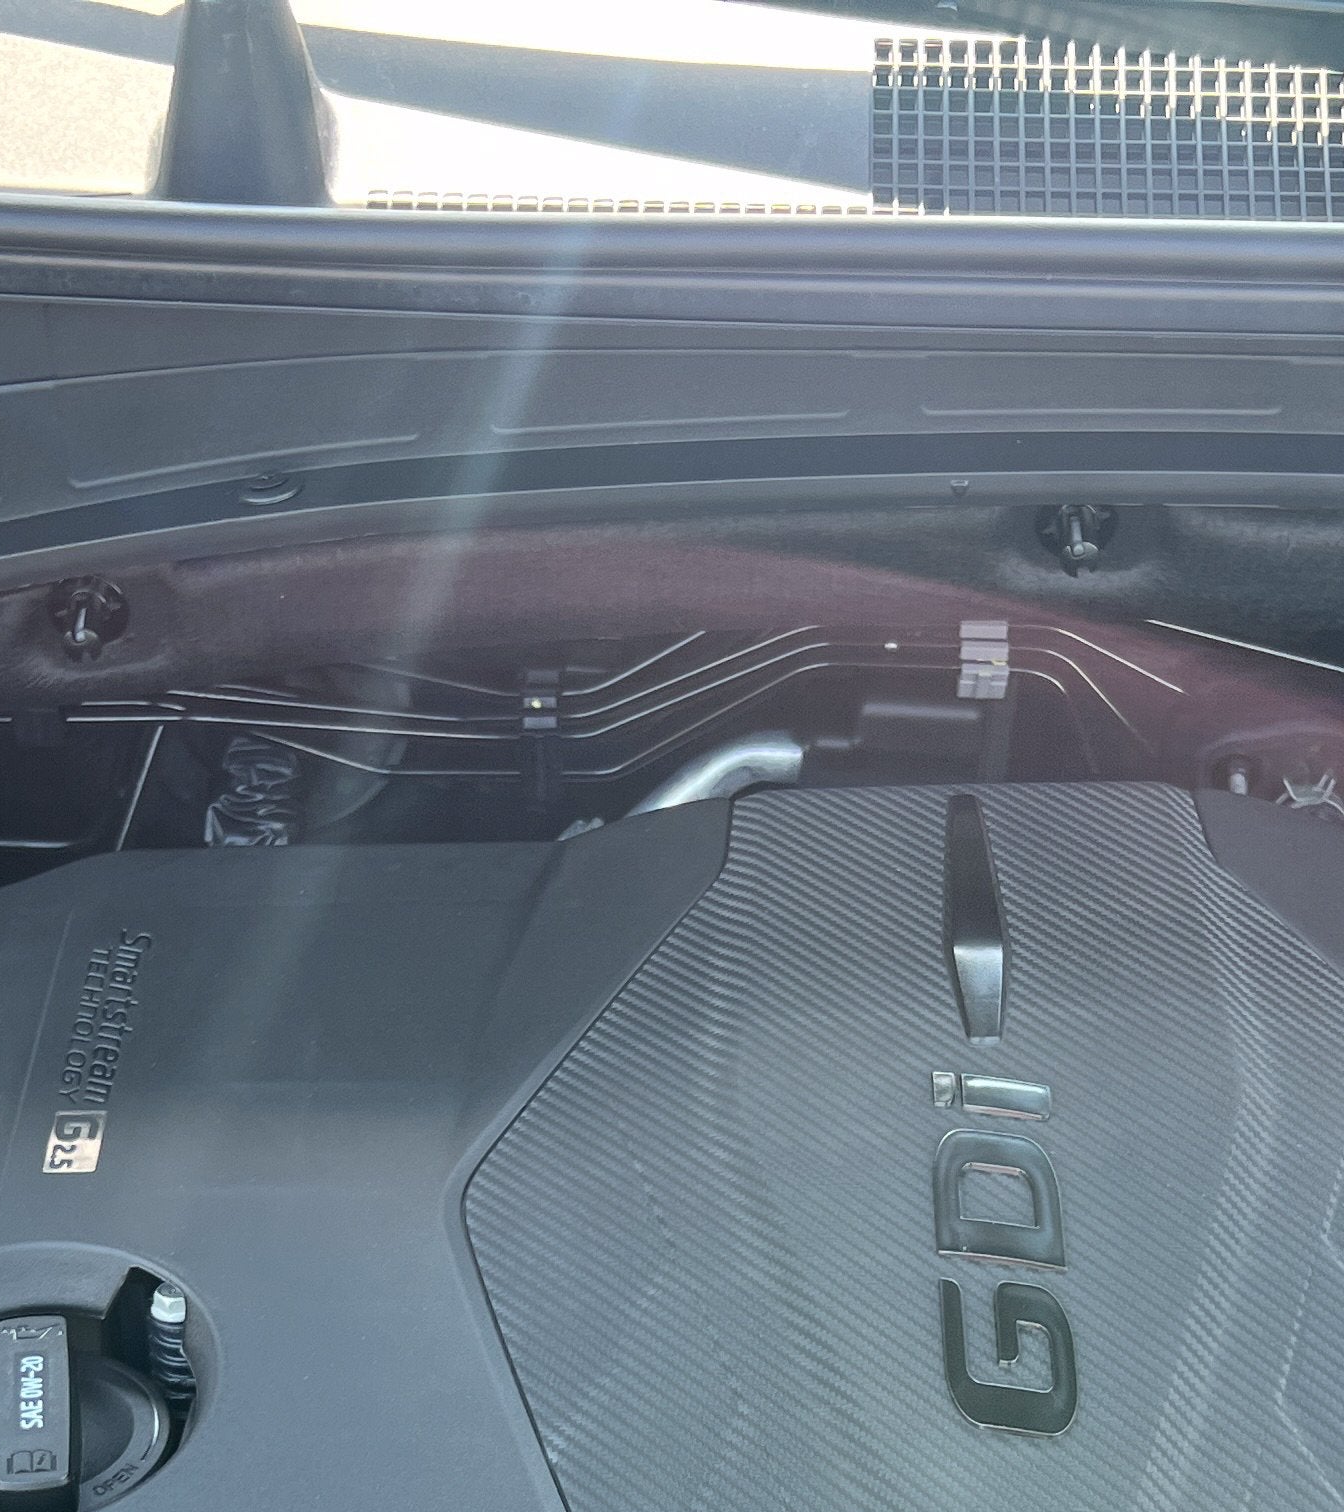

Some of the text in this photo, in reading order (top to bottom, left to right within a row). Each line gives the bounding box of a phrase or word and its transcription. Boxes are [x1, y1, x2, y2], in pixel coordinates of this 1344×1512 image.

[58, 947, 111, 1105] TECHNOLOGY
[83, 928, 152, 1104] Smartstream
[931, 1071, 1078, 1437] GDi
[19, 1355, 44, 1430] SAE 0W-20
[92, 1462, 139, 1497] OPEN
